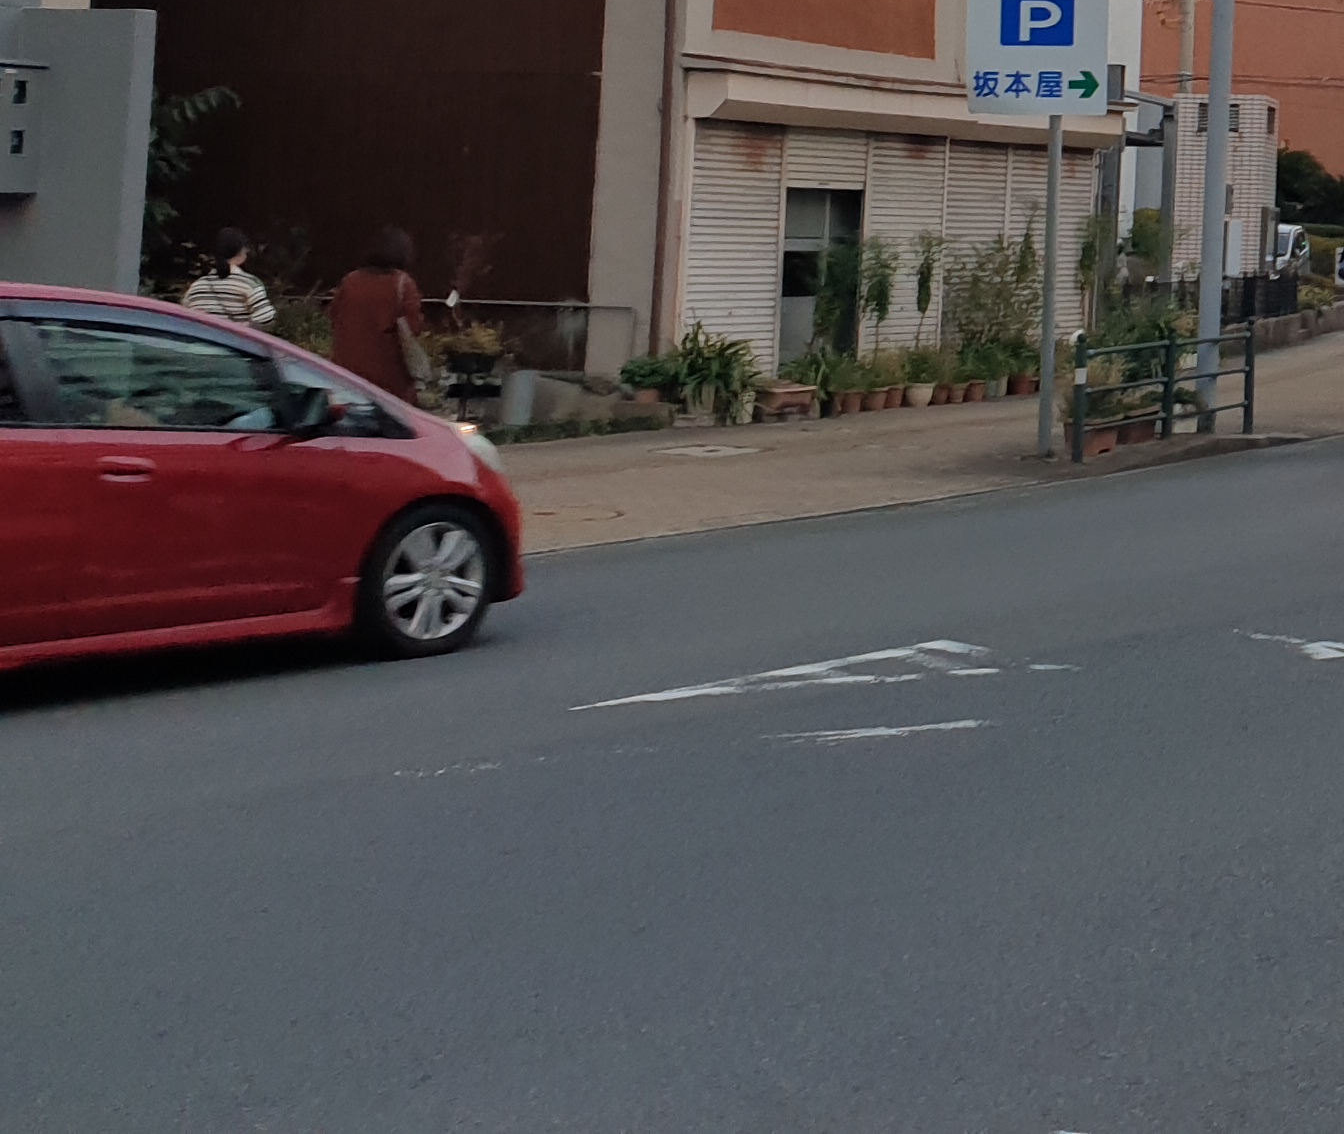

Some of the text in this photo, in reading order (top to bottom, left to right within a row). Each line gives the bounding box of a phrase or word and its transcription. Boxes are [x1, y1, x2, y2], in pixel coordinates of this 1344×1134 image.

[1018, 0, 1062, 42] P
[972, 70, 1063, 99] 坂本屋
